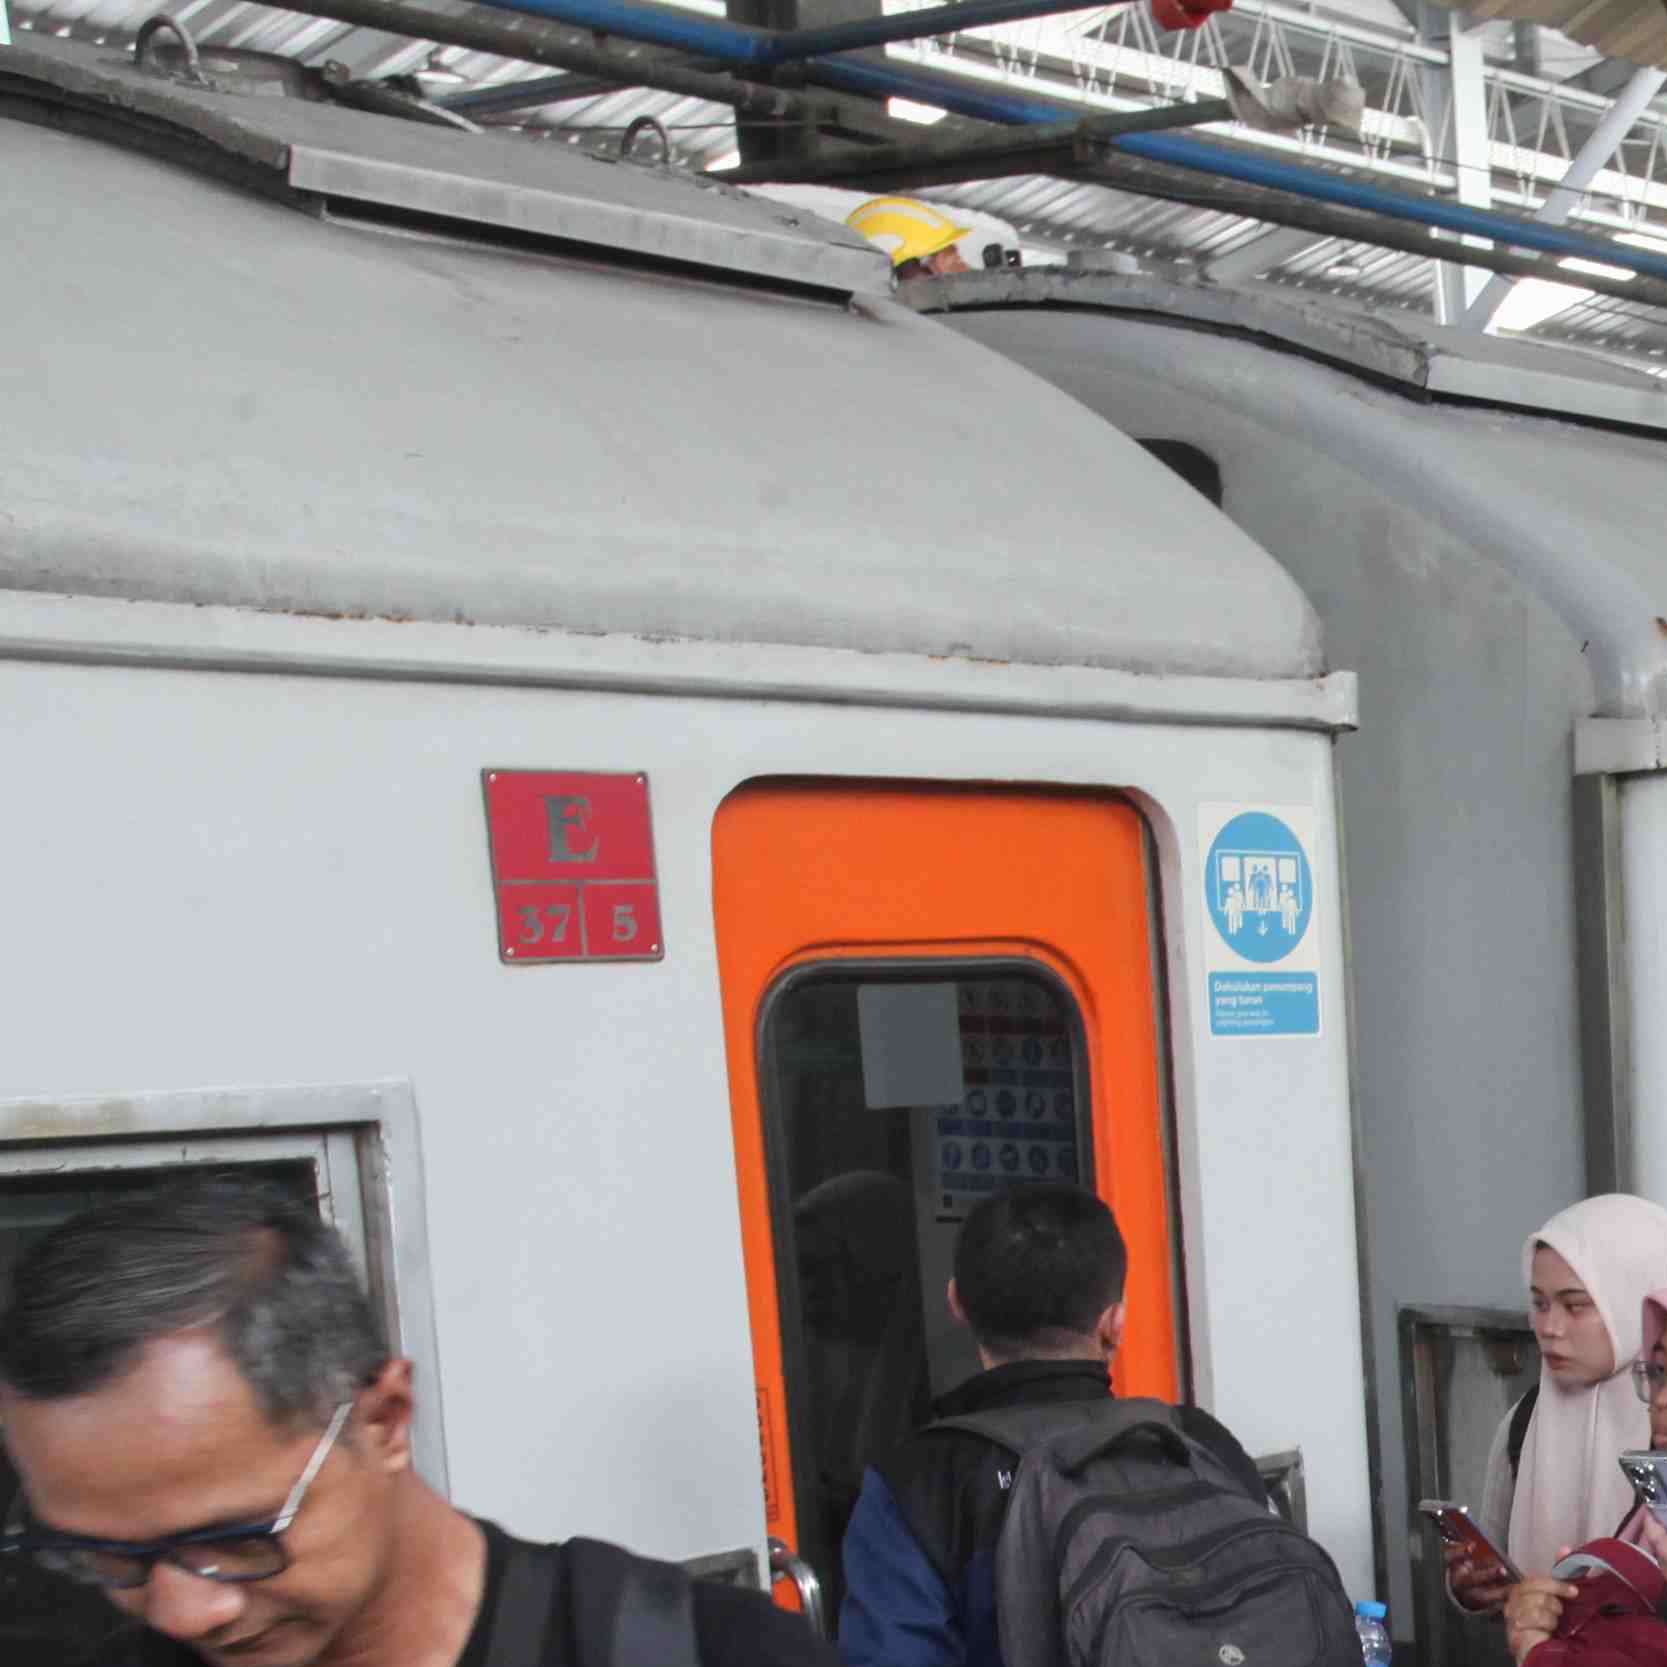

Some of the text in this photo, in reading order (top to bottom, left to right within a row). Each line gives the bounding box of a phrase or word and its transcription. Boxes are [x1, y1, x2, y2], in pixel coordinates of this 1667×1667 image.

[543, 795, 599, 863] E
[517, 903, 638, 943] 37 5
